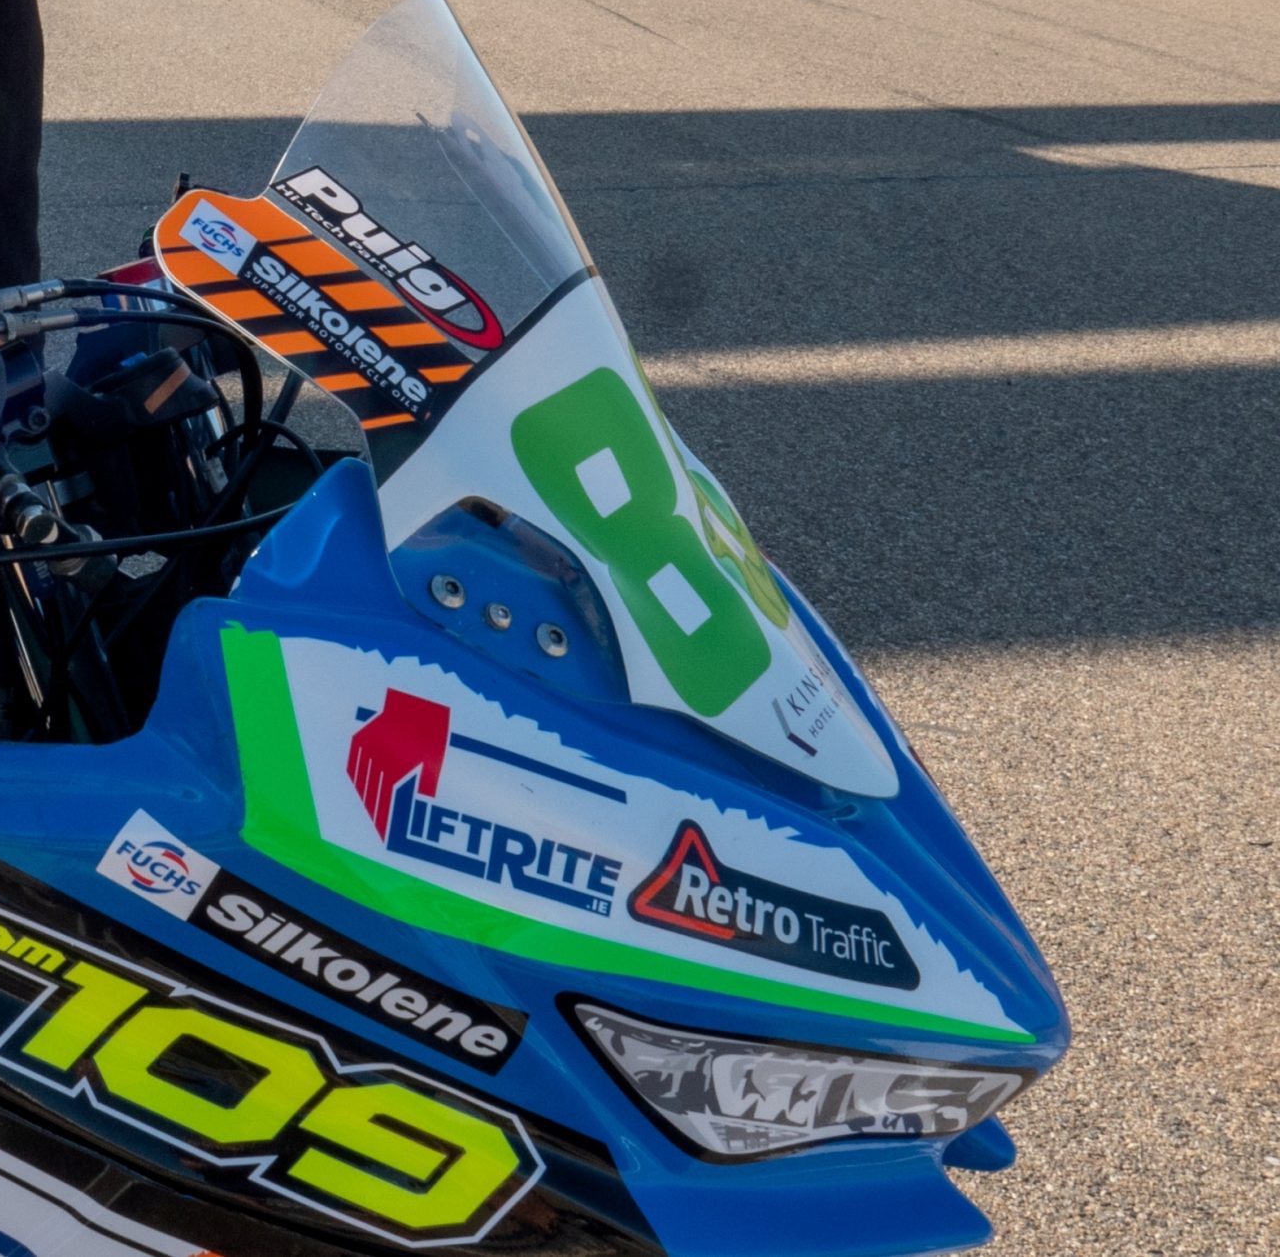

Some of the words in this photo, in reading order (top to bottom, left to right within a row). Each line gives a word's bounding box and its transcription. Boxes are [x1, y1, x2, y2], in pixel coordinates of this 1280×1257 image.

[190, 216, 246, 259] FUCHS
[274, 183, 346, 241] Hi-Tech
[347, 239, 396, 280] Parts
[287, 168, 468, 311] Puig
[244, 270, 306, 321] SUPERIOR
[308, 320, 389, 390] MOTORCYCLE
[392, 389, 420, 415] OILS
[251, 255, 429, 404] Silkolene
[116, 839, 202, 898] FUCHS
[387, 773, 623, 903] LIFTRITE
[206, 892, 508, 1058] Silkolene
[675, 864, 800, 944] Retro
[804, 912, 895, 969] Traffic
[22, 962, 520, 1228] 109
